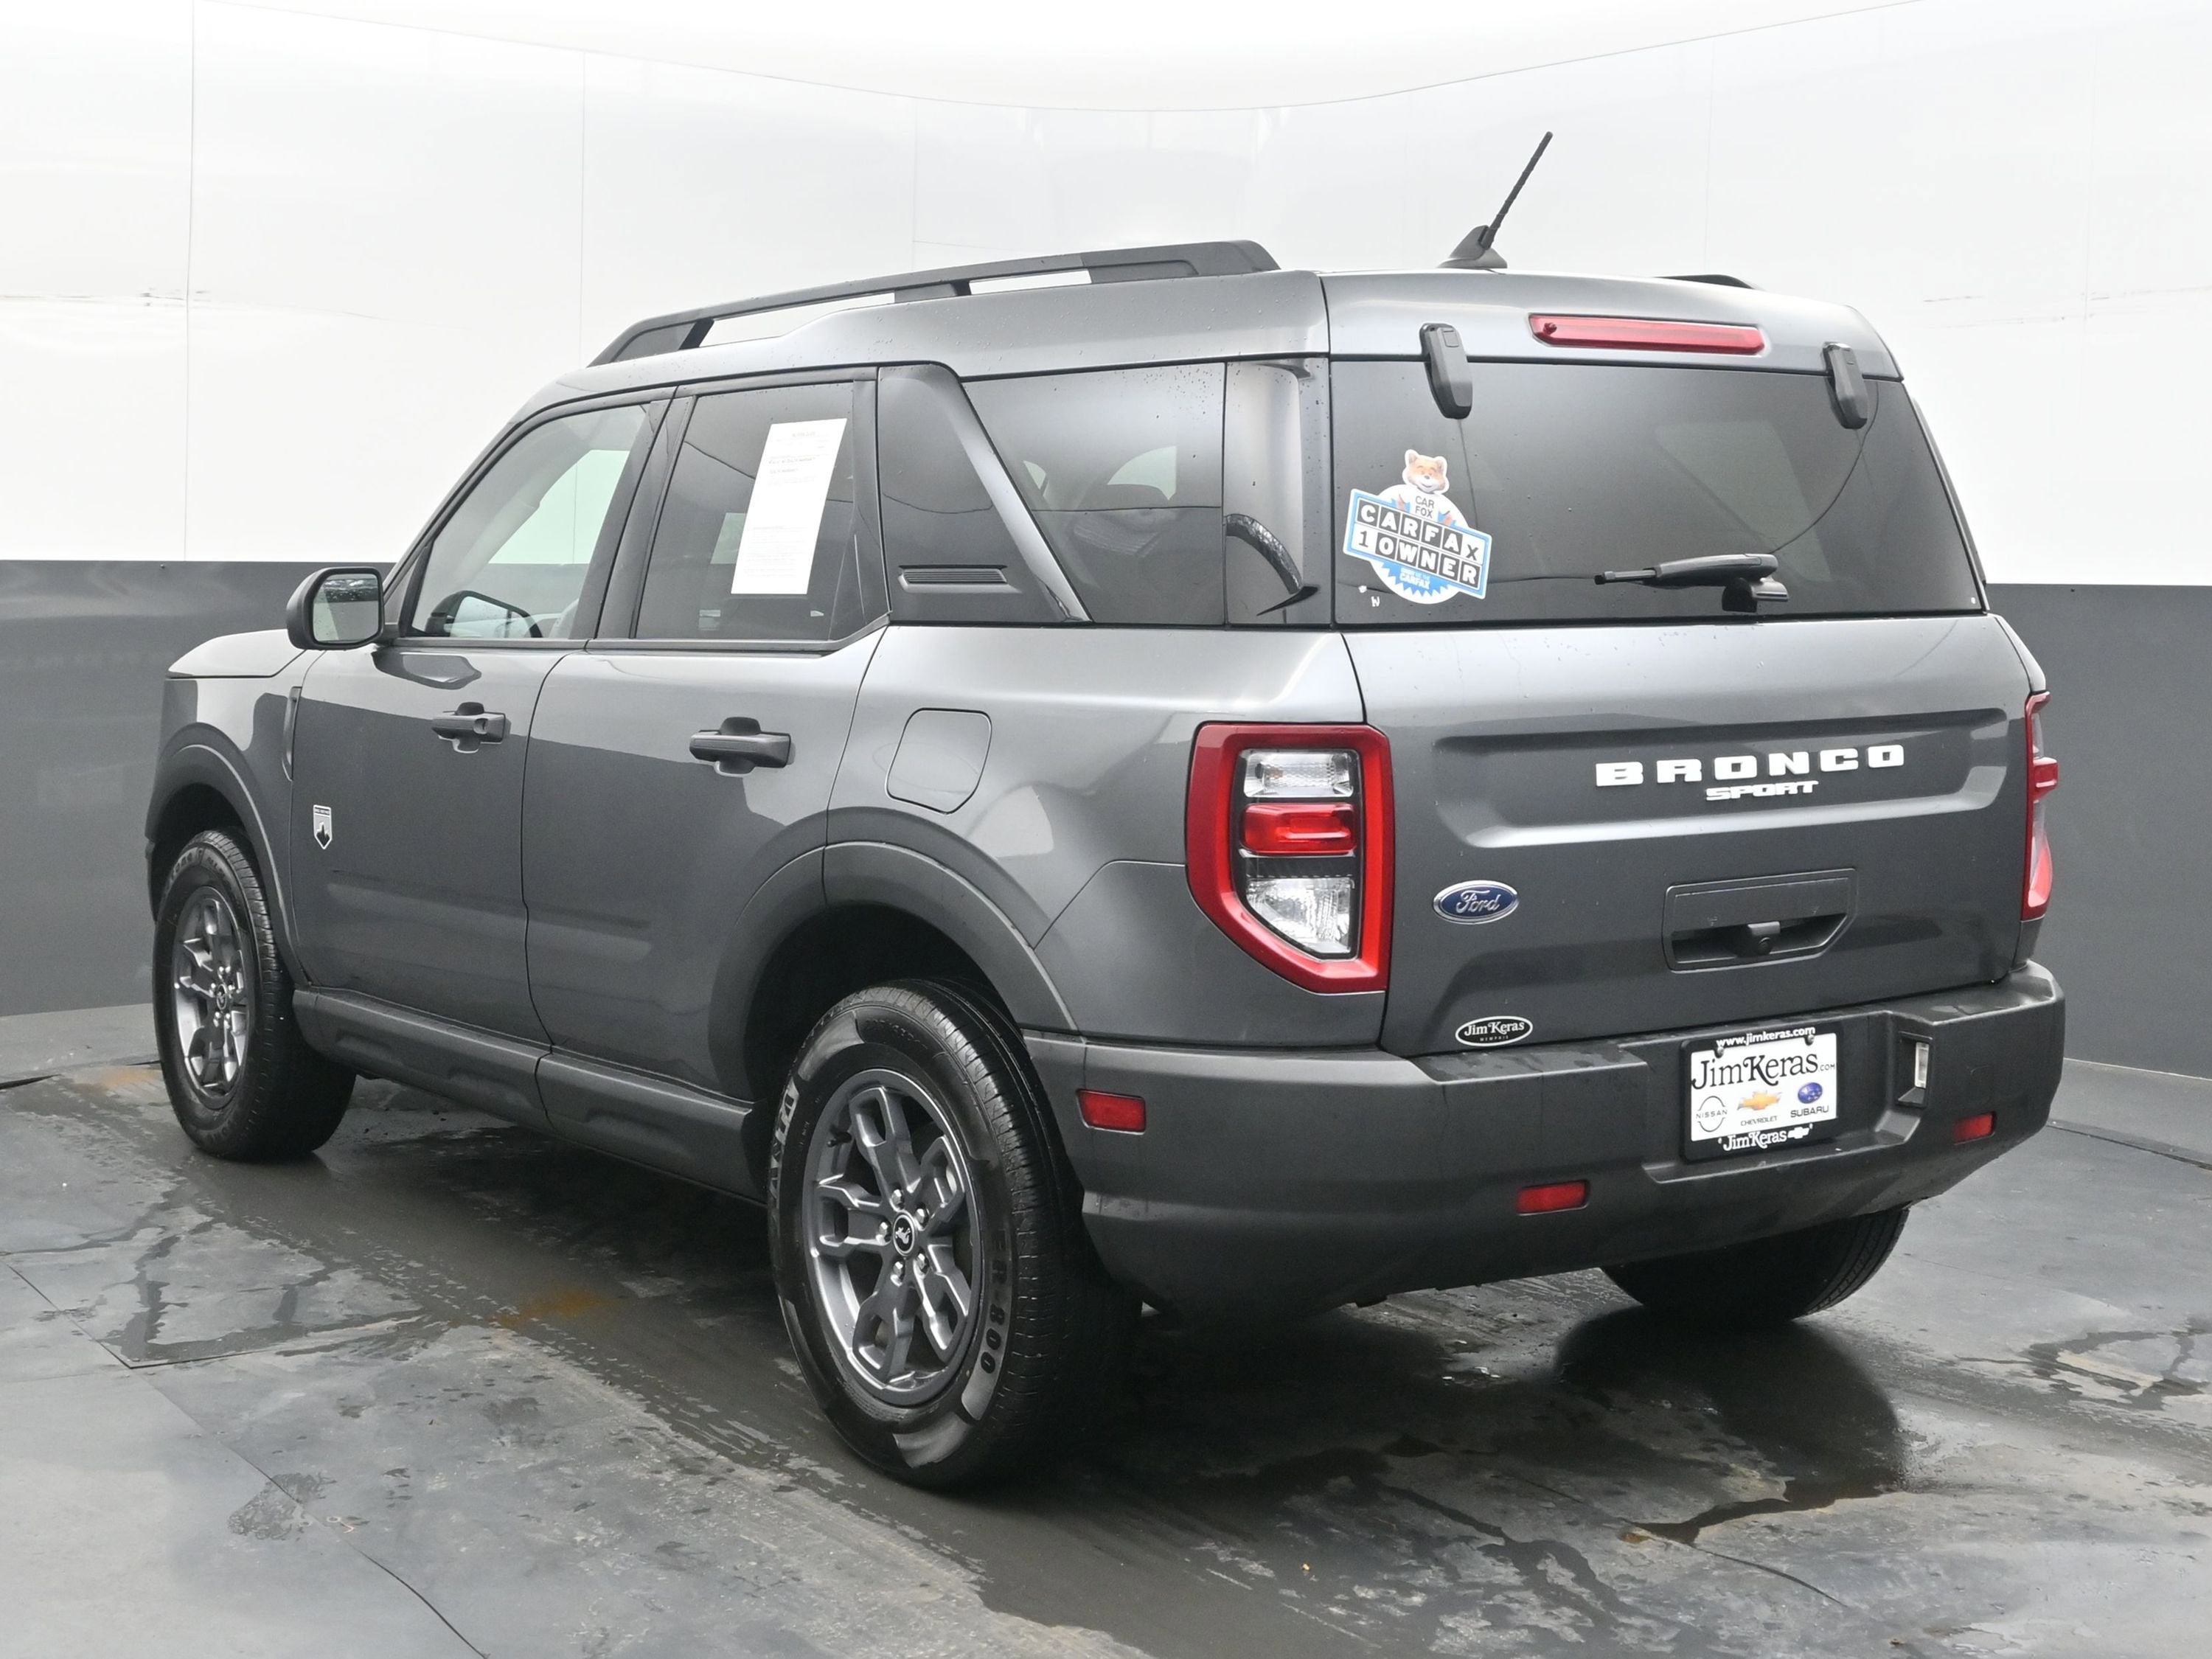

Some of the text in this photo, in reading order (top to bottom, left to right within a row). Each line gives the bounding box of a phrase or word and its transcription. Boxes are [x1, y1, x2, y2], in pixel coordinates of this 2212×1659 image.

[1415, 495, 1435, 508] CAR
[1415, 507, 1433, 519] FOX
[1360, 504, 1479, 561] CARFAX
[1358, 530, 1369, 548] 1
[1378, 537, 1477, 585] OWNER
[1595, 744, 1905, 787] BRONCO
[1705, 780, 1819, 801] SPORT
[1455, 889, 1502, 914] Ford
[1716, 1026, 1816, 1047] www.jimkeras.com
[1695, 1109, 1728, 1119] NISSAN
[1740, 1115, 1778, 1127] CHEVROLET
[1790, 1105, 1829, 1118] SUBARU
